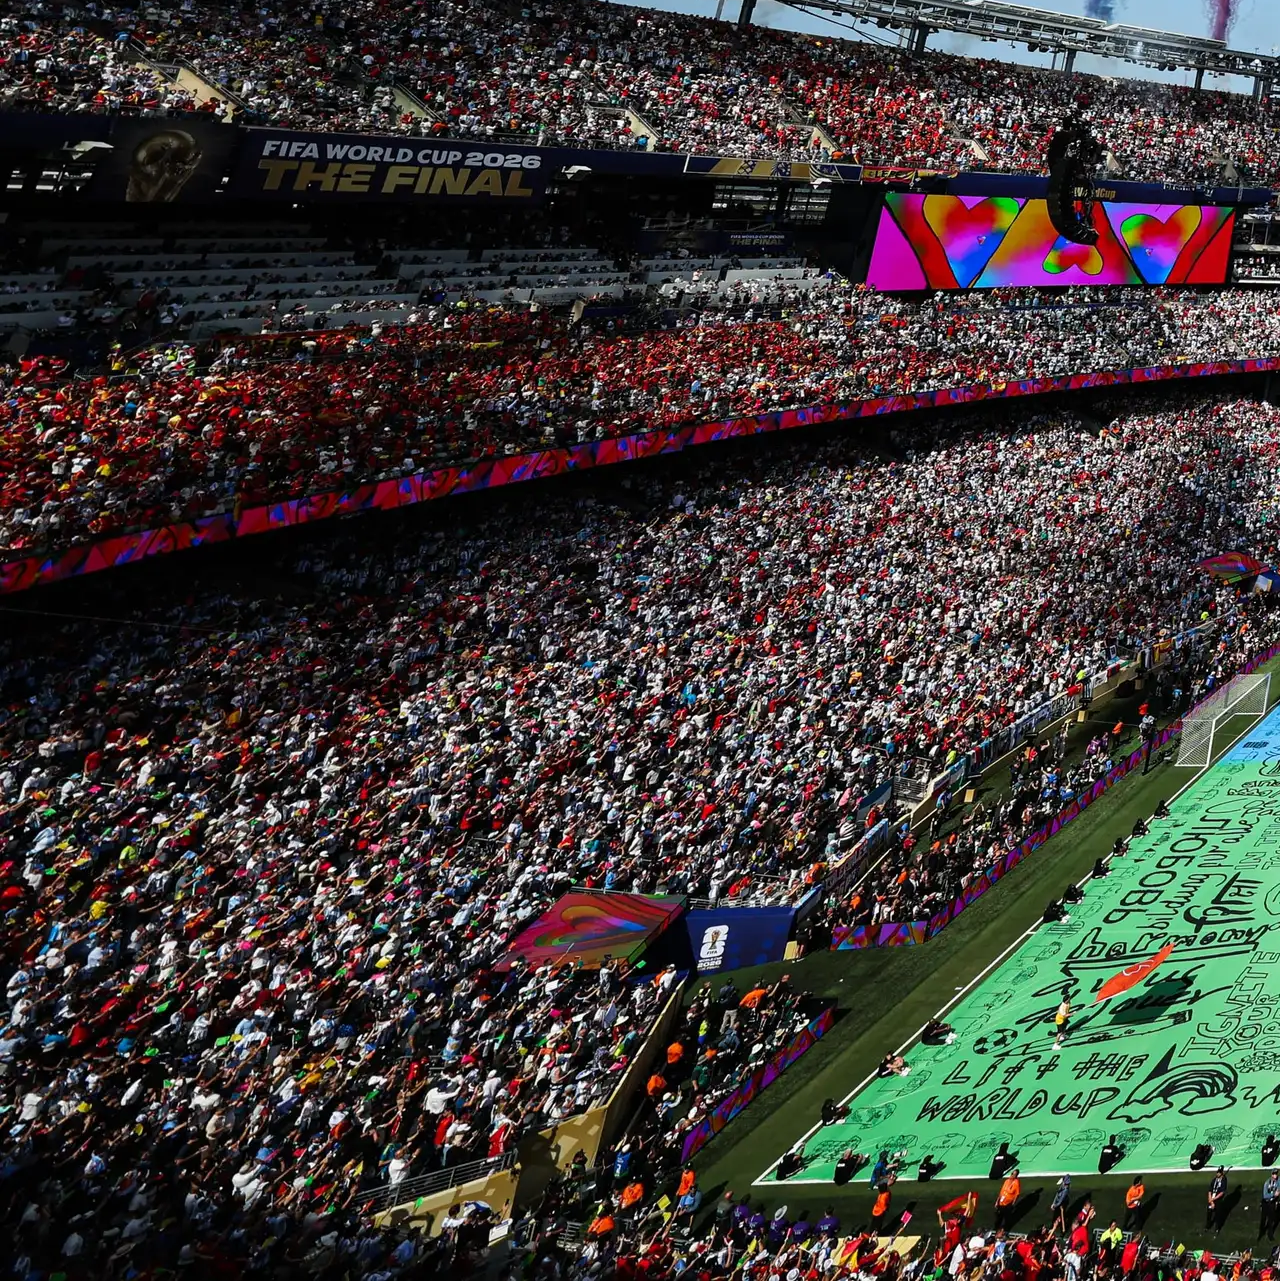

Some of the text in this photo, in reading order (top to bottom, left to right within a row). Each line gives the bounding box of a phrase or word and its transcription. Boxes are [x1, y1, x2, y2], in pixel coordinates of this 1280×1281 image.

[262, 140, 542, 169] FIFA WORLD CUP 2026
[258, 159, 533, 197] THE FINAL
[730, 238, 754, 246] THE
[1103, 815, 1234, 924] ЛЮБОВЬ
[1136, 817, 1260, 931] bildung alle
[1235, 851, 1266, 871] IN
[1218, 993, 1280, 1059] YOUR
[915, 1086, 1049, 1123] WORLD
